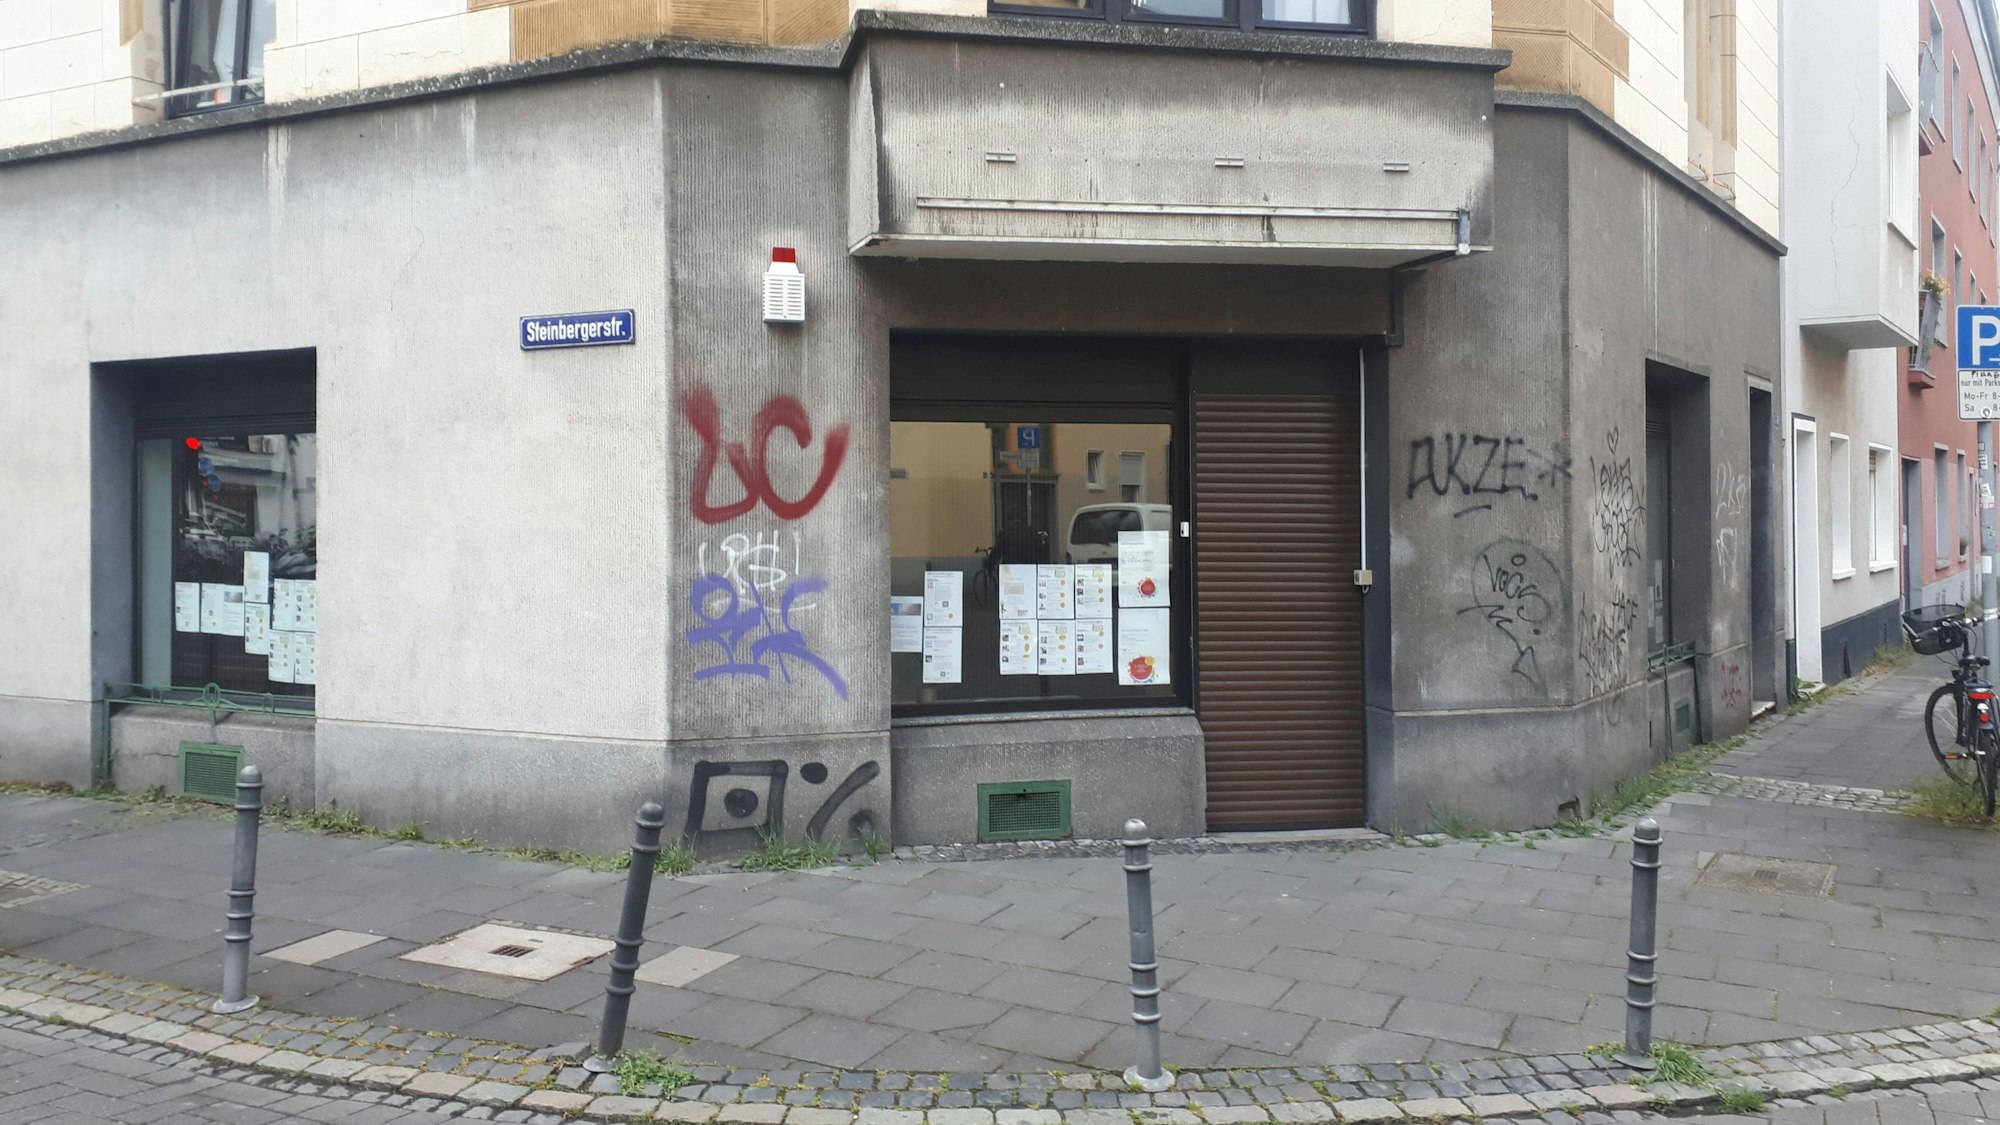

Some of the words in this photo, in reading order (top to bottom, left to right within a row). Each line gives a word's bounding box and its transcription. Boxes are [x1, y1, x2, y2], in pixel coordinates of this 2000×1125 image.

[526, 316, 626, 343] Steinbergerstr.
[1972, 315, 2000, 366] P
[1973, 379, 1983, 387] mit
[1964, 391, 1989, 400] Mo-Fr
[1964, 403, 1975, 412] Sa
